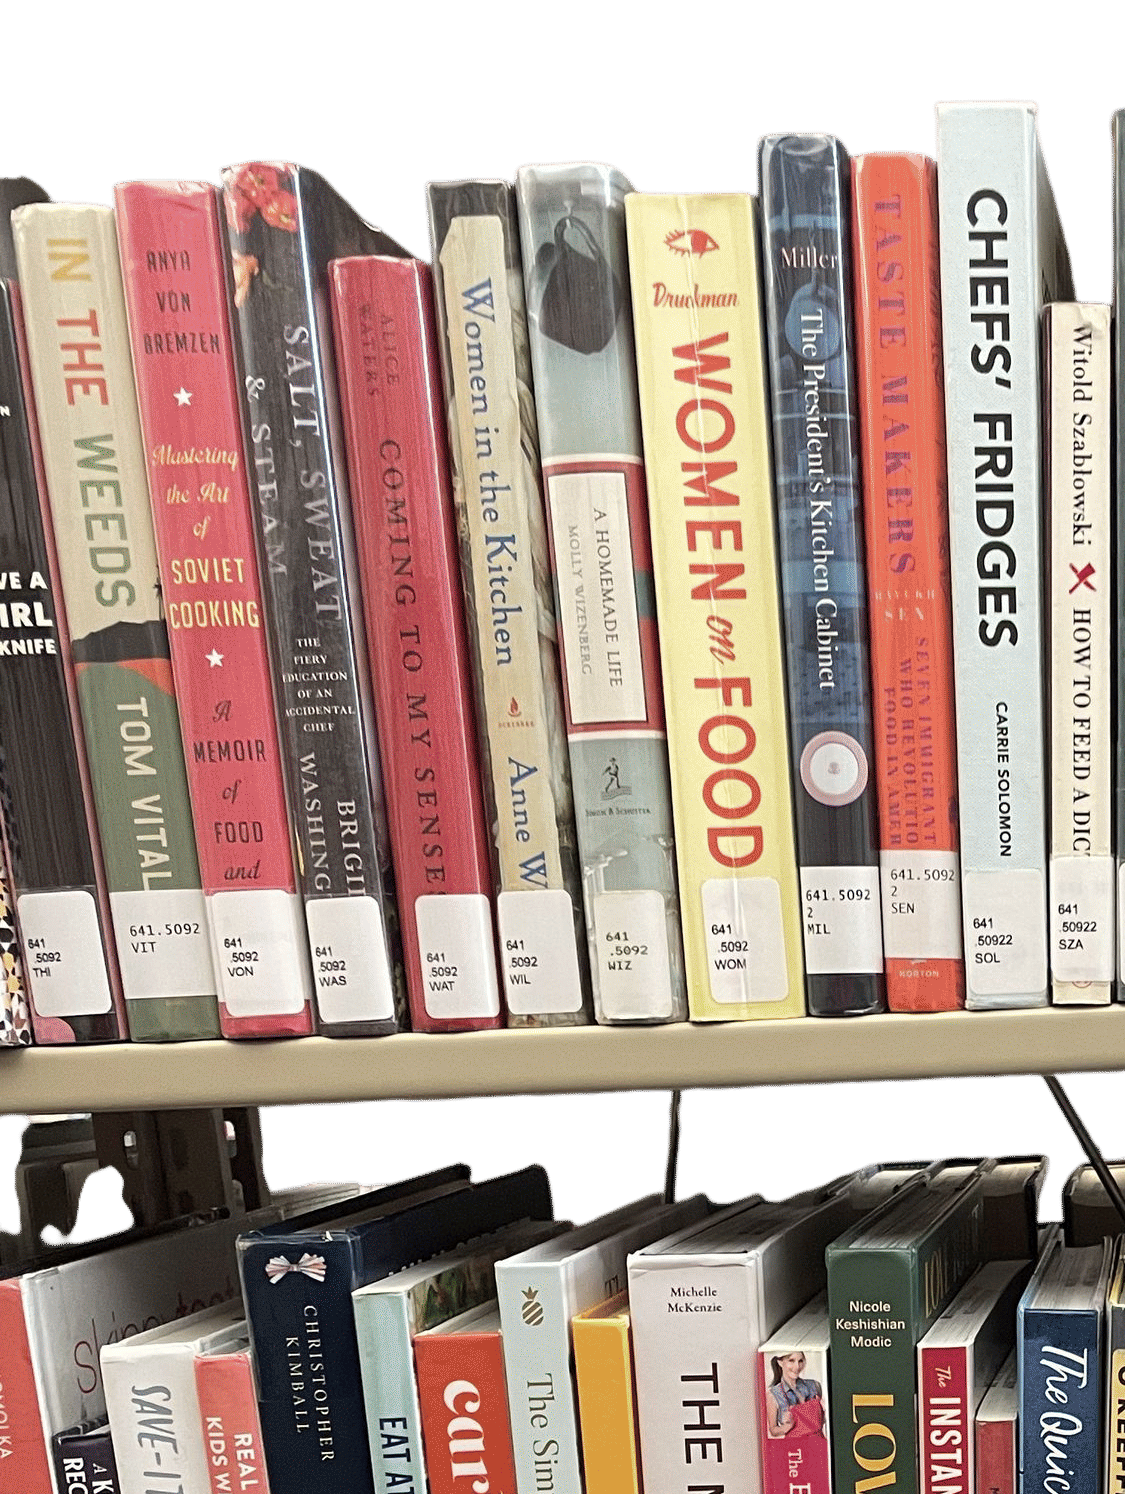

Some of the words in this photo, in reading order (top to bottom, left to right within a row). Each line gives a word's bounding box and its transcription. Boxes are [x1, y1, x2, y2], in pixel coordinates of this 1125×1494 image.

[45, 237, 92, 283] IN
[780, 246, 838, 269] Miller
[157, 291, 191, 312] VON
[652, 282, 738, 309] Druckman
[144, 333, 220, 355] BREMZEN
[462, 277, 496, 418] Women
[800, 308, 818, 359] The
[56, 310, 109, 406] THE
[152, 445, 240, 473] Mastering
[474, 426, 493, 457] in
[671, 331, 746, 600] WOMEN
[167, 483, 190, 504] the
[197, 482, 230, 503] Art
[480, 470, 499, 520] the
[73, 433, 136, 608] WEEDS
[193, 517, 210, 540] of
[972, 413, 1018, 647] FRIDGES
[809, 498, 830, 592] Kitchen
[171, 558, 245, 584] SOVIET
[169, 601, 259, 629] COOKING
[484, 533, 523, 667] Kitchen
[815, 599, 838, 689] Cabinet
[995, 700, 1011, 764] CARRIE
[695, 677, 764, 867] FOOD
[996, 765, 1011, 857] SOLOMON
[129, 923, 200, 936] 641.5092
[972, 917, 993, 929] 641
[131, 941, 156, 953] VIT
[975, 952, 1001, 963] SOL
[667, 1302, 722, 1315] McKenzie
[670, 1287, 717, 1298] Michelle
[849, 1301, 891, 1313] Nicole
[835, 1318, 905, 1332] Keshishian
[850, 1335, 891, 1348] Modic
[526, 1372, 548, 1430] The
[680, 1363, 723, 1464] THE
[205, 1416, 229, 1464] KIDS
[379, 1417, 408, 1461] EAT
[233, 1432, 256, 1490] REAL
